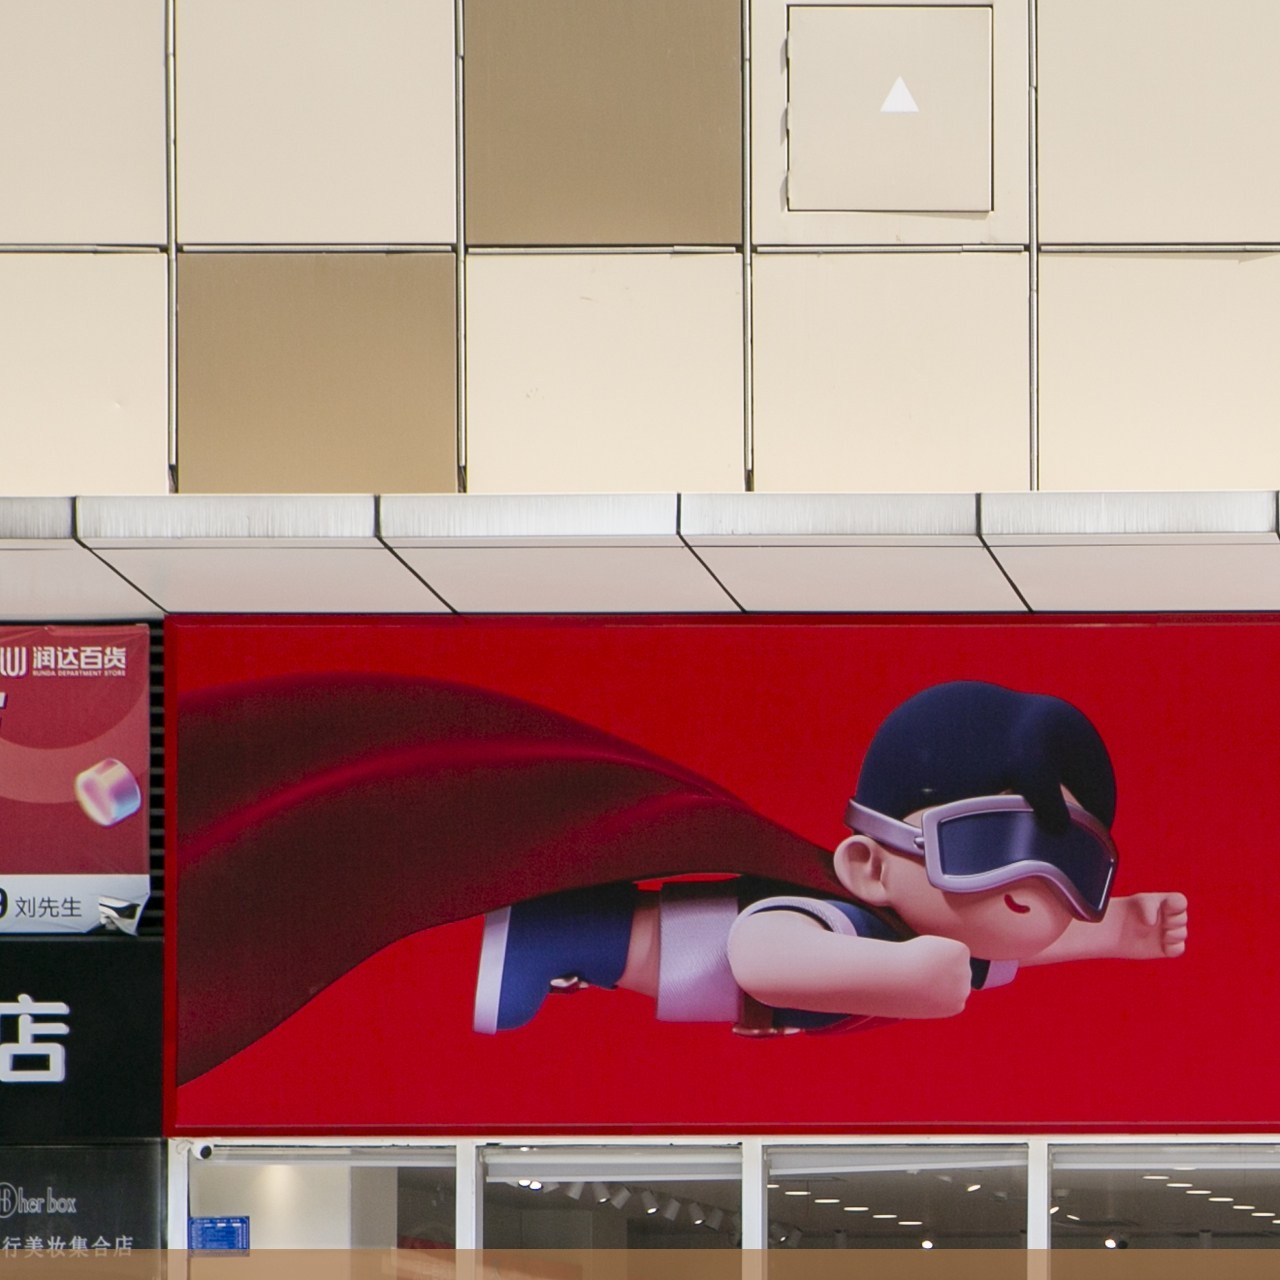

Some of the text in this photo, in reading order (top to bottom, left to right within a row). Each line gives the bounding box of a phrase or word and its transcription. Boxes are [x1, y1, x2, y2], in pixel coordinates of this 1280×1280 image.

[32, 646, 126, 669] 润达百货
[15, 895, 82, 919] 刘先生
[0, 993, 70, 1082] 店
[18, 1187, 45, 1213] her
[47, 1187, 77, 1213] box
[2, 1235, 134, 1259] 行美妆集合店
